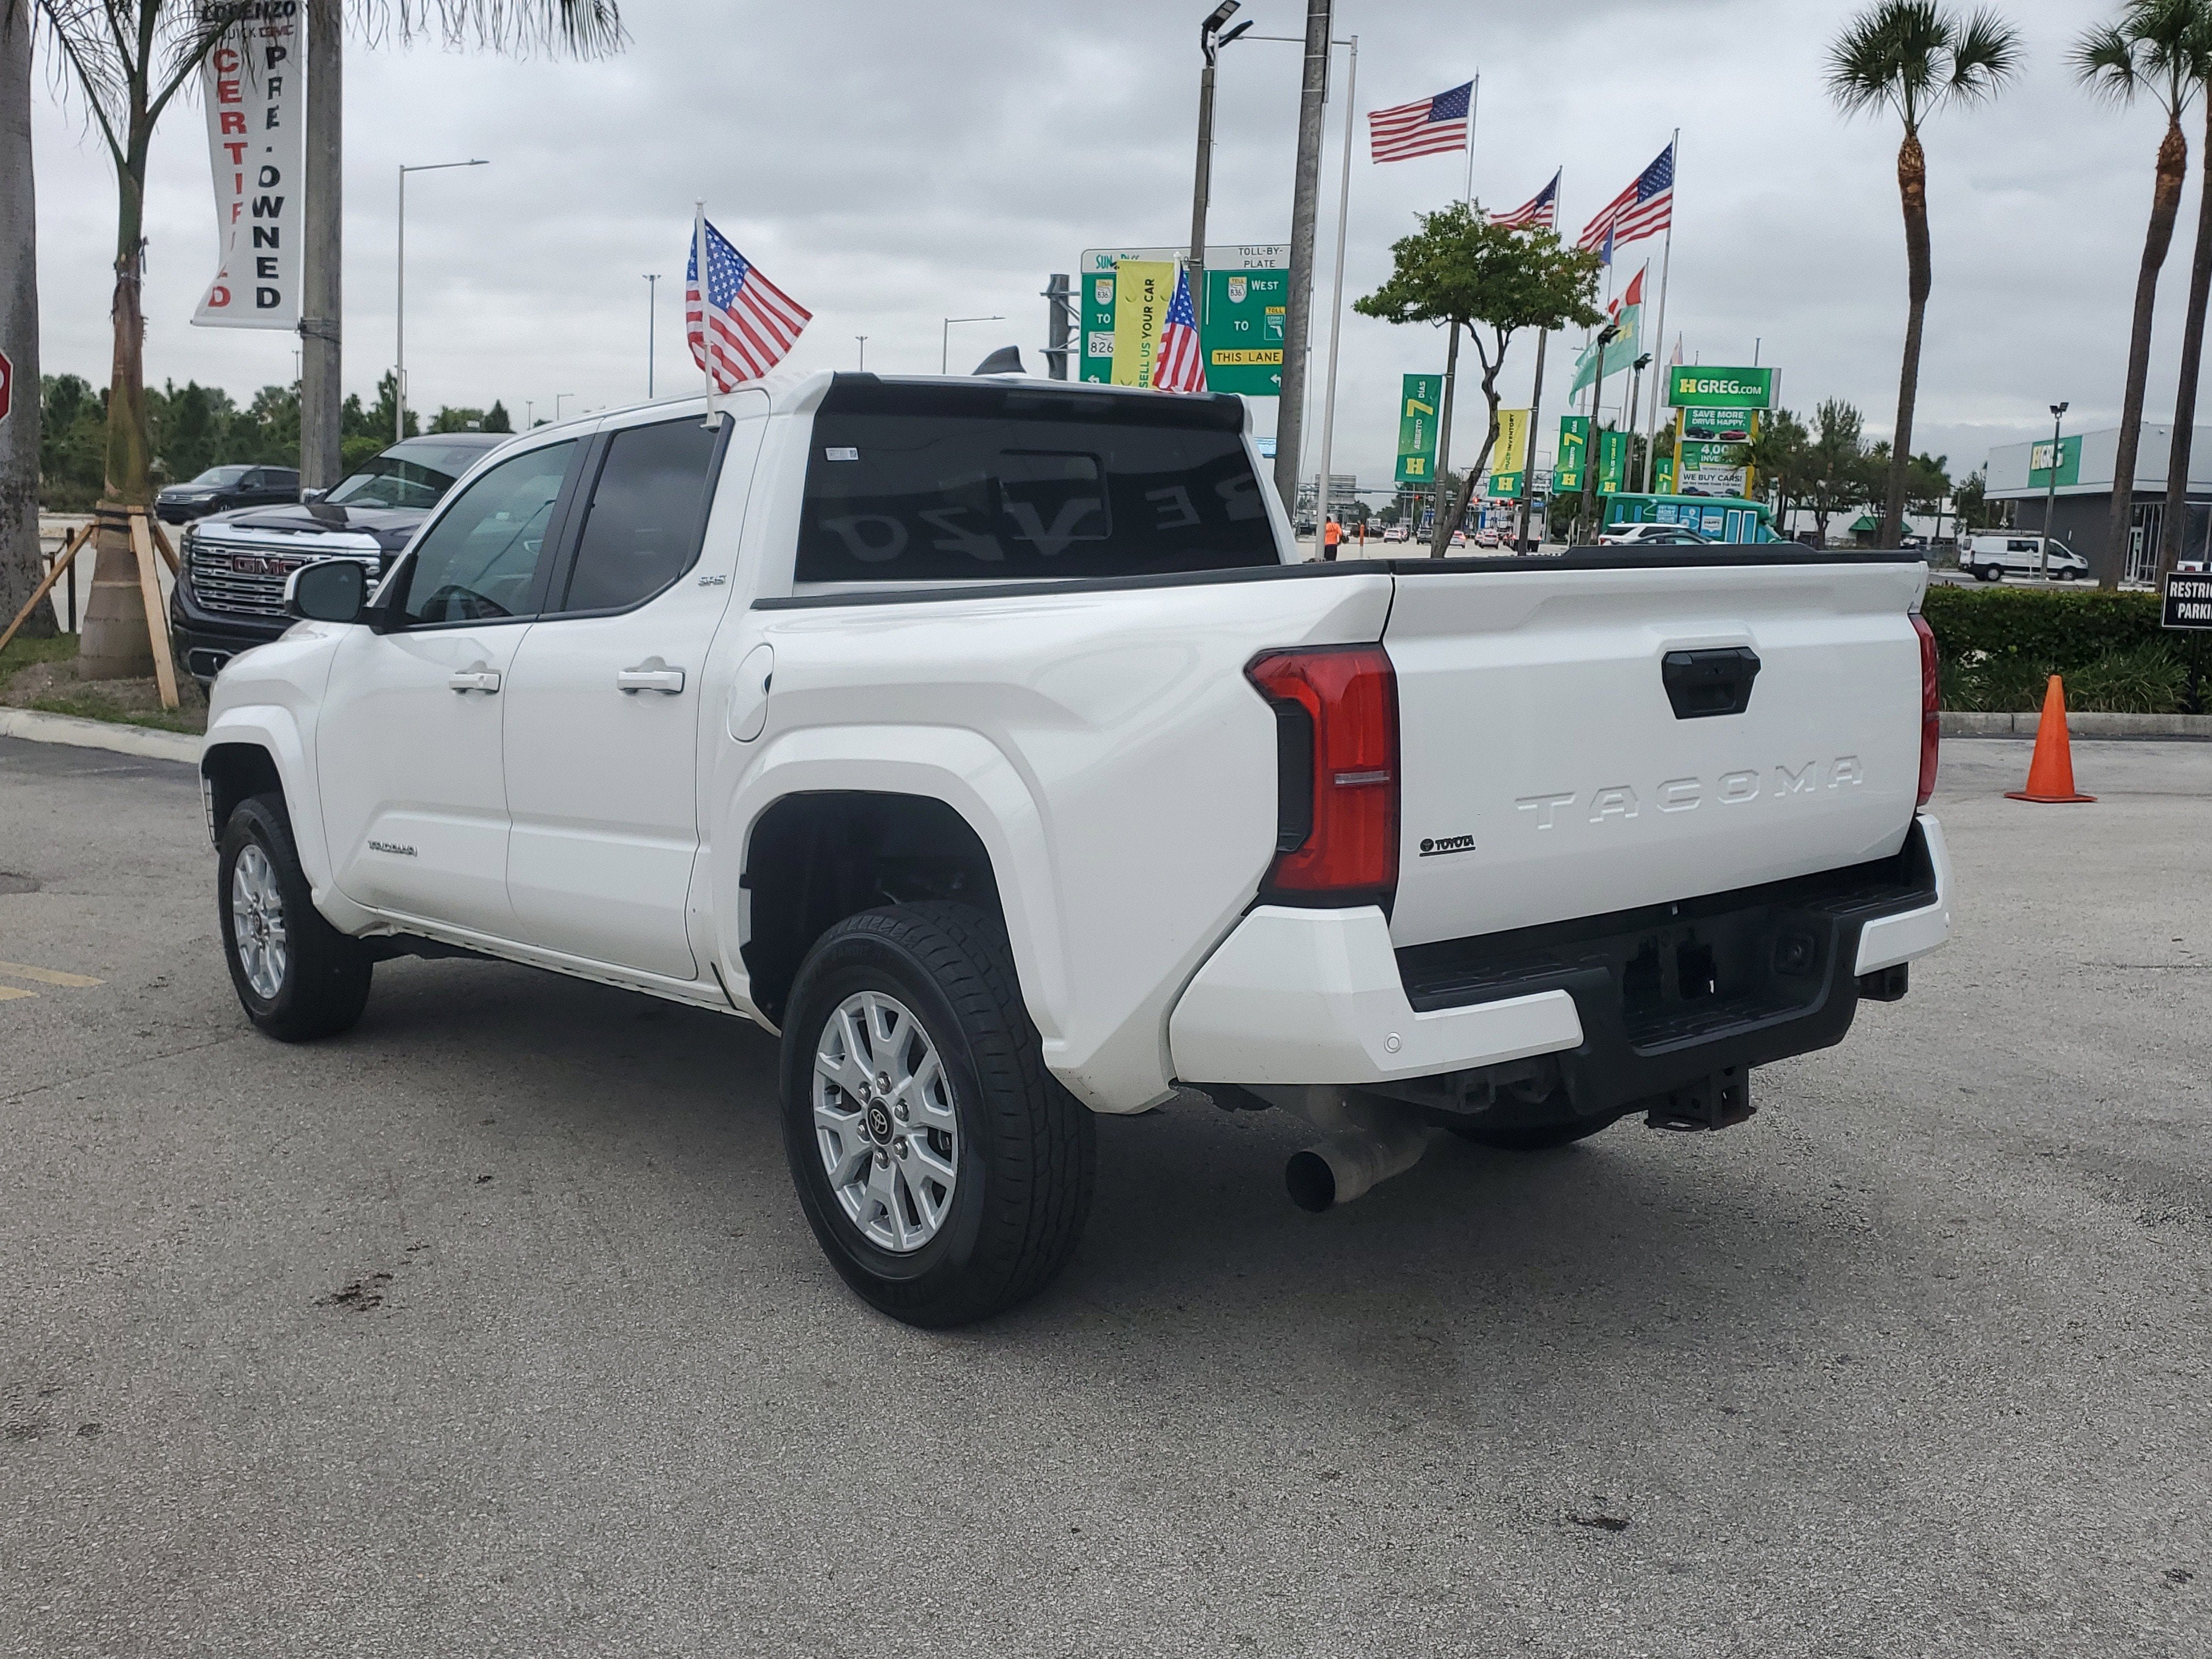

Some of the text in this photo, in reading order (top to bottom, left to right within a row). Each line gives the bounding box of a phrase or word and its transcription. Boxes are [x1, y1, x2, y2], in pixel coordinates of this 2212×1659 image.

[202, 1, 296, 21] LOENZO
[1239, 247, 1283, 256] TOLL-BY-
[1251, 280, 1279, 290] WEST
[1097, 314, 1111, 324] TO
[1234, 321, 1249, 331] TO
[1139, 279, 1155, 388] SELL US YOUR CAR
[1090, 343, 1114, 353] 826
[1216, 352, 1280, 362] THIS LANE
[1406, 399, 1434, 417] 7
[1717, 411, 1746, 419] MORE.
[1506, 413, 1515, 452] INVENTORY
[1564, 432, 1583, 446] 7
[235, 556, 302, 576] GMC
[2170, 582, 2212, 598] RESTRI
[2177, 602, 2212, 619] PARKI
[1514, 755, 1863, 830] TACOMA
[1435, 834, 1474, 850] TOYOTA
